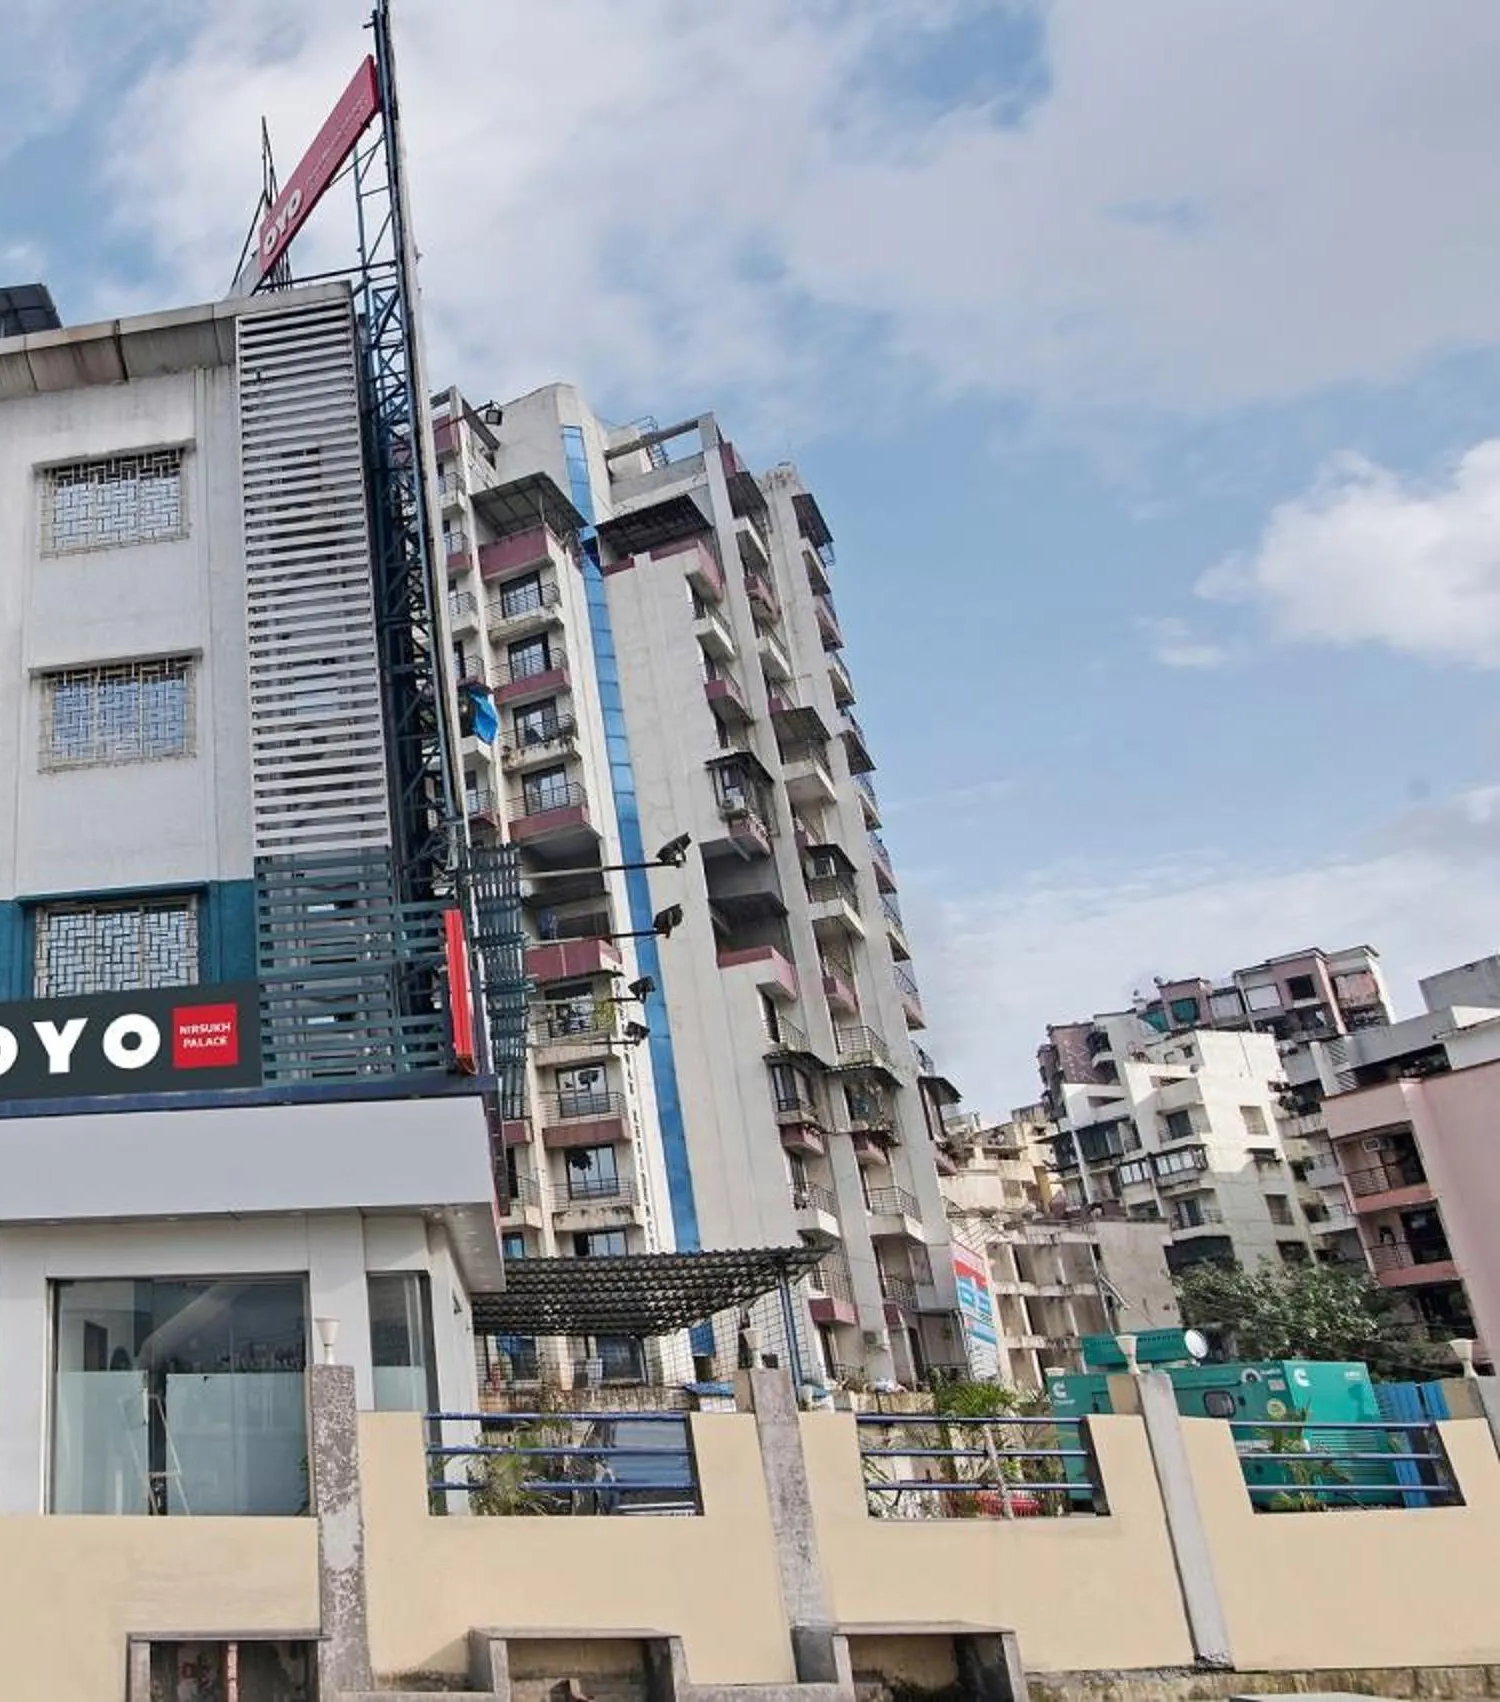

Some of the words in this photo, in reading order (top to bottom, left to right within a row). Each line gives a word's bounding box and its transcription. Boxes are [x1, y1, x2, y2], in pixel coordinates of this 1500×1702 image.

[264, 189, 303, 256] OYO
[179, 1022, 231, 1035] NIRSUKH
[183, 1036, 228, 1049] PALACE
